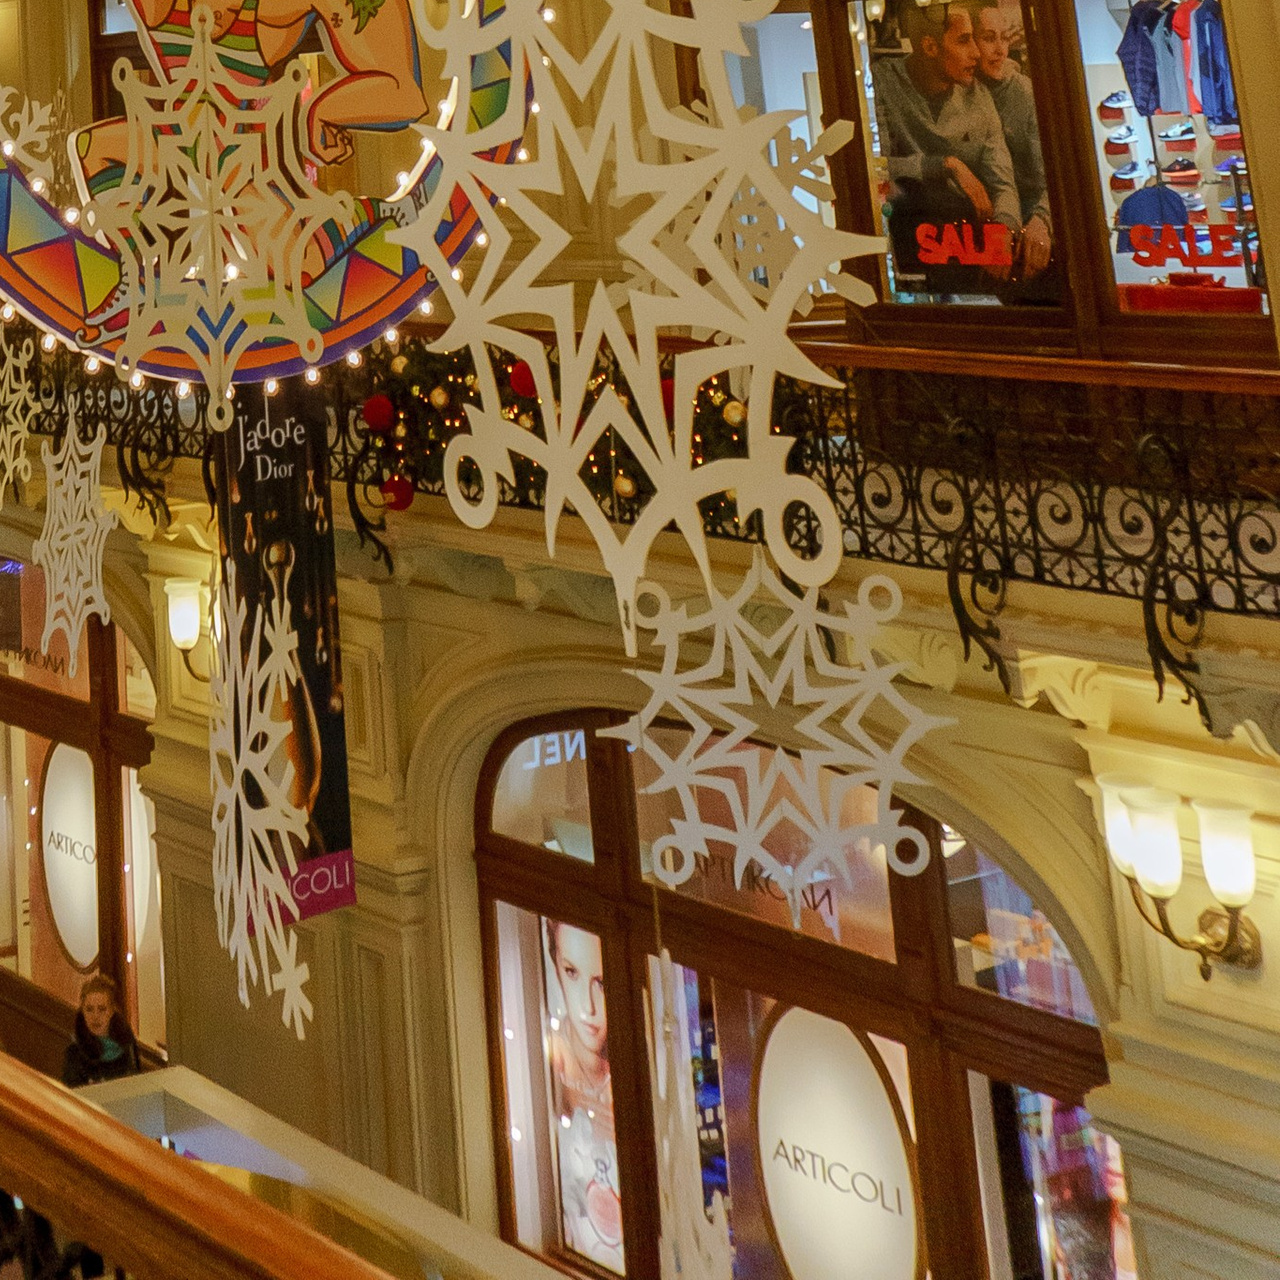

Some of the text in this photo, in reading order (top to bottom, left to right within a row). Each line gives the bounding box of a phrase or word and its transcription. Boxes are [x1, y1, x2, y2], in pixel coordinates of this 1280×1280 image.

[916, 223, 1012, 266] SALE
[1130, 224, 1244, 267] SALE
[255, 454, 295, 481] Dior
[47, 830, 97, 865] ARTICO
[773, 1138, 903, 1216] ARTICOLI
